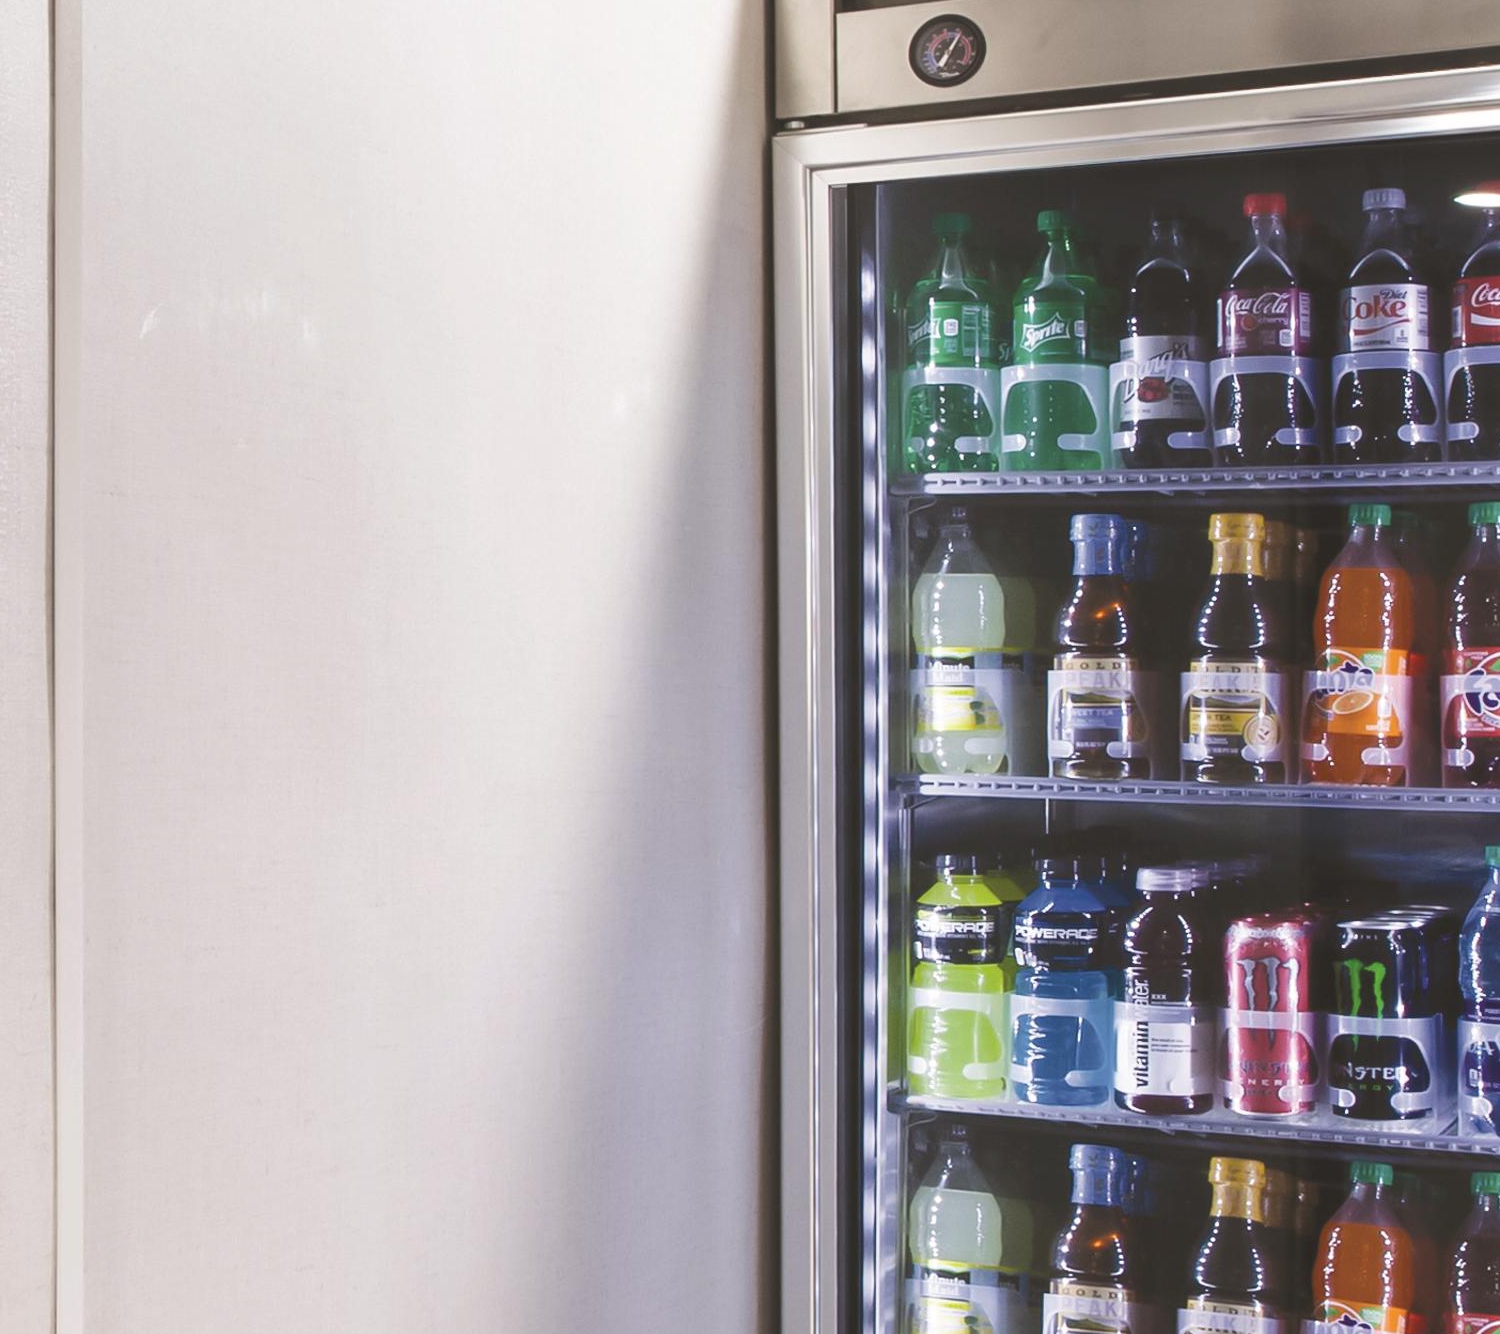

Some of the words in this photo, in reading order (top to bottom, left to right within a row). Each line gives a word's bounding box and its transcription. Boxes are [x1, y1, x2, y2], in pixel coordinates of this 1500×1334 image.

[1224, 291, 1289, 317] Coca-Cola
[1341, 294, 1407, 322] Coke
[1024, 318, 1065, 349] Sprite
[1014, 925, 1099, 940] POWERADE
